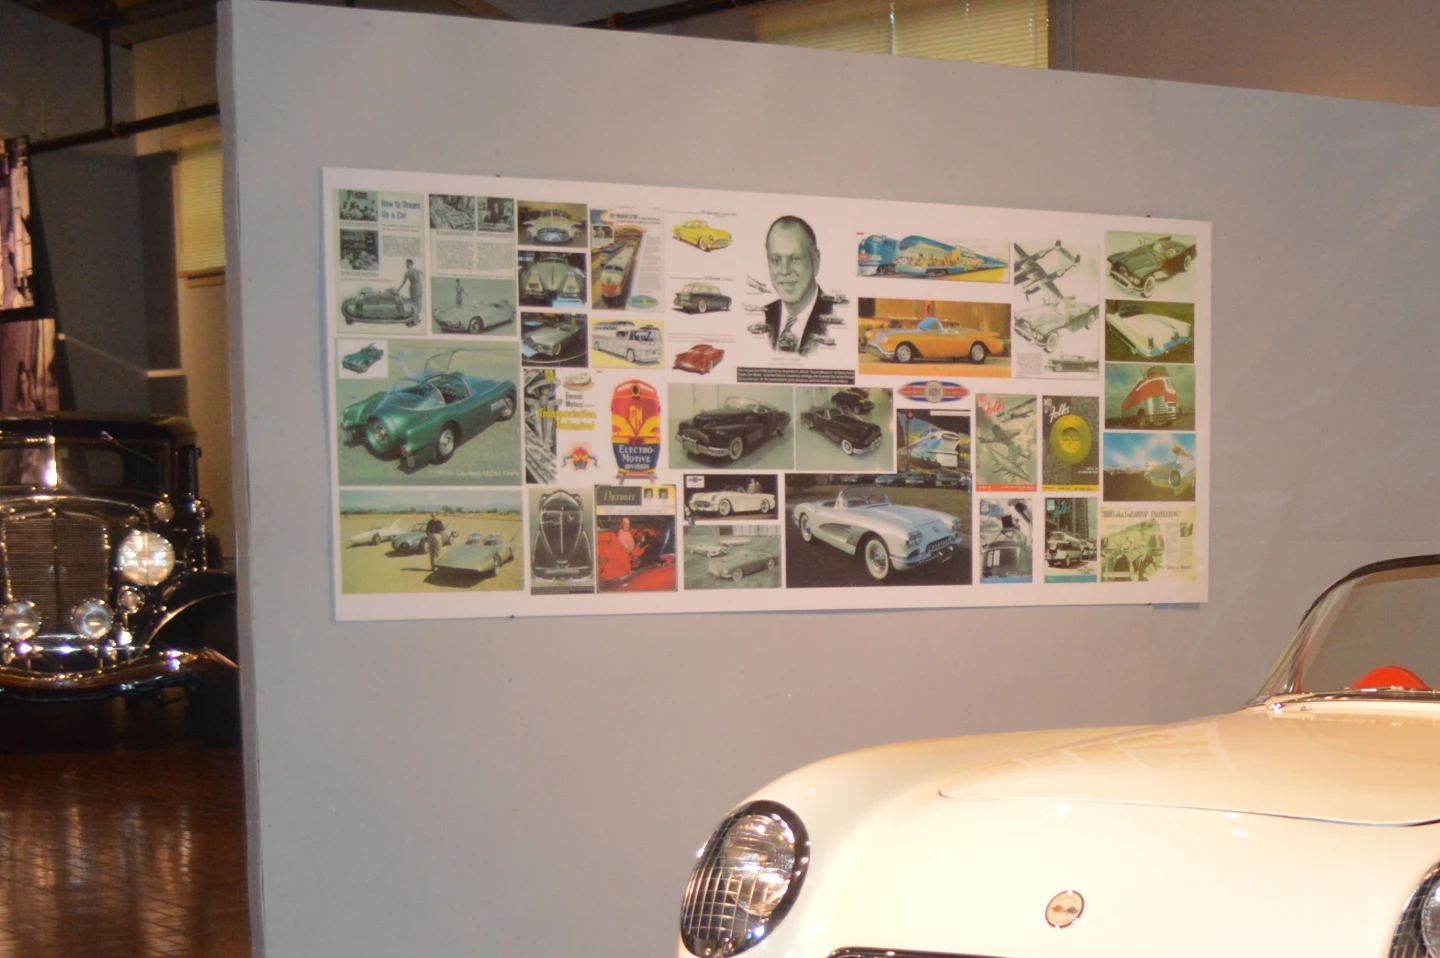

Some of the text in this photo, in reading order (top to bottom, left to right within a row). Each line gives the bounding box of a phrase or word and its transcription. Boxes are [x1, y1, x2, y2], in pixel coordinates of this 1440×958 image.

[1049, 402, 1070, 423] Folks
[619, 444, 656, 454] ELECTRO-
[622, 454, 652, 463] MOTIVE
